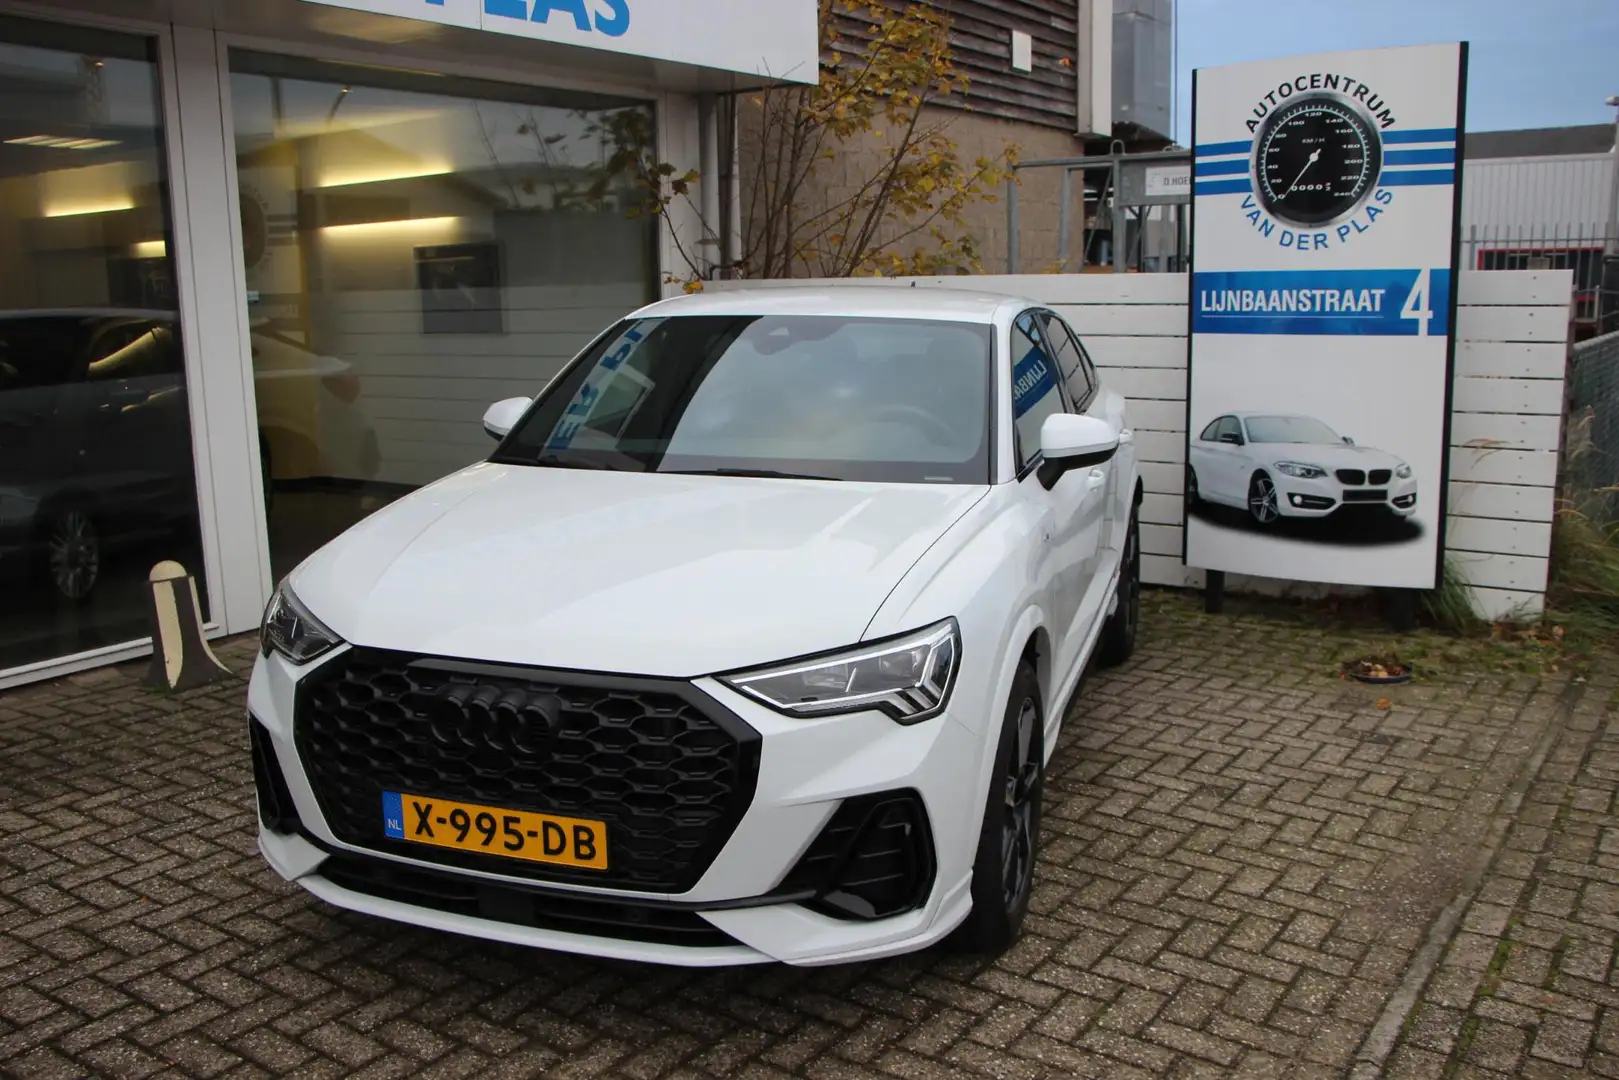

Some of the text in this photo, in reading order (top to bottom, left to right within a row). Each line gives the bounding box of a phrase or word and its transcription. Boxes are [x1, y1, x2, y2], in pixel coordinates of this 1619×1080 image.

[1245, 73, 1396, 133] AUTOCENTRUM
[1241, 188, 1393, 251] VAN DER PLAS
[1201, 268, 1433, 336] LIJNBAANSTRAAT 4
[387, 818, 402, 831] NL
[412, 801, 597, 861] X-995-DB
